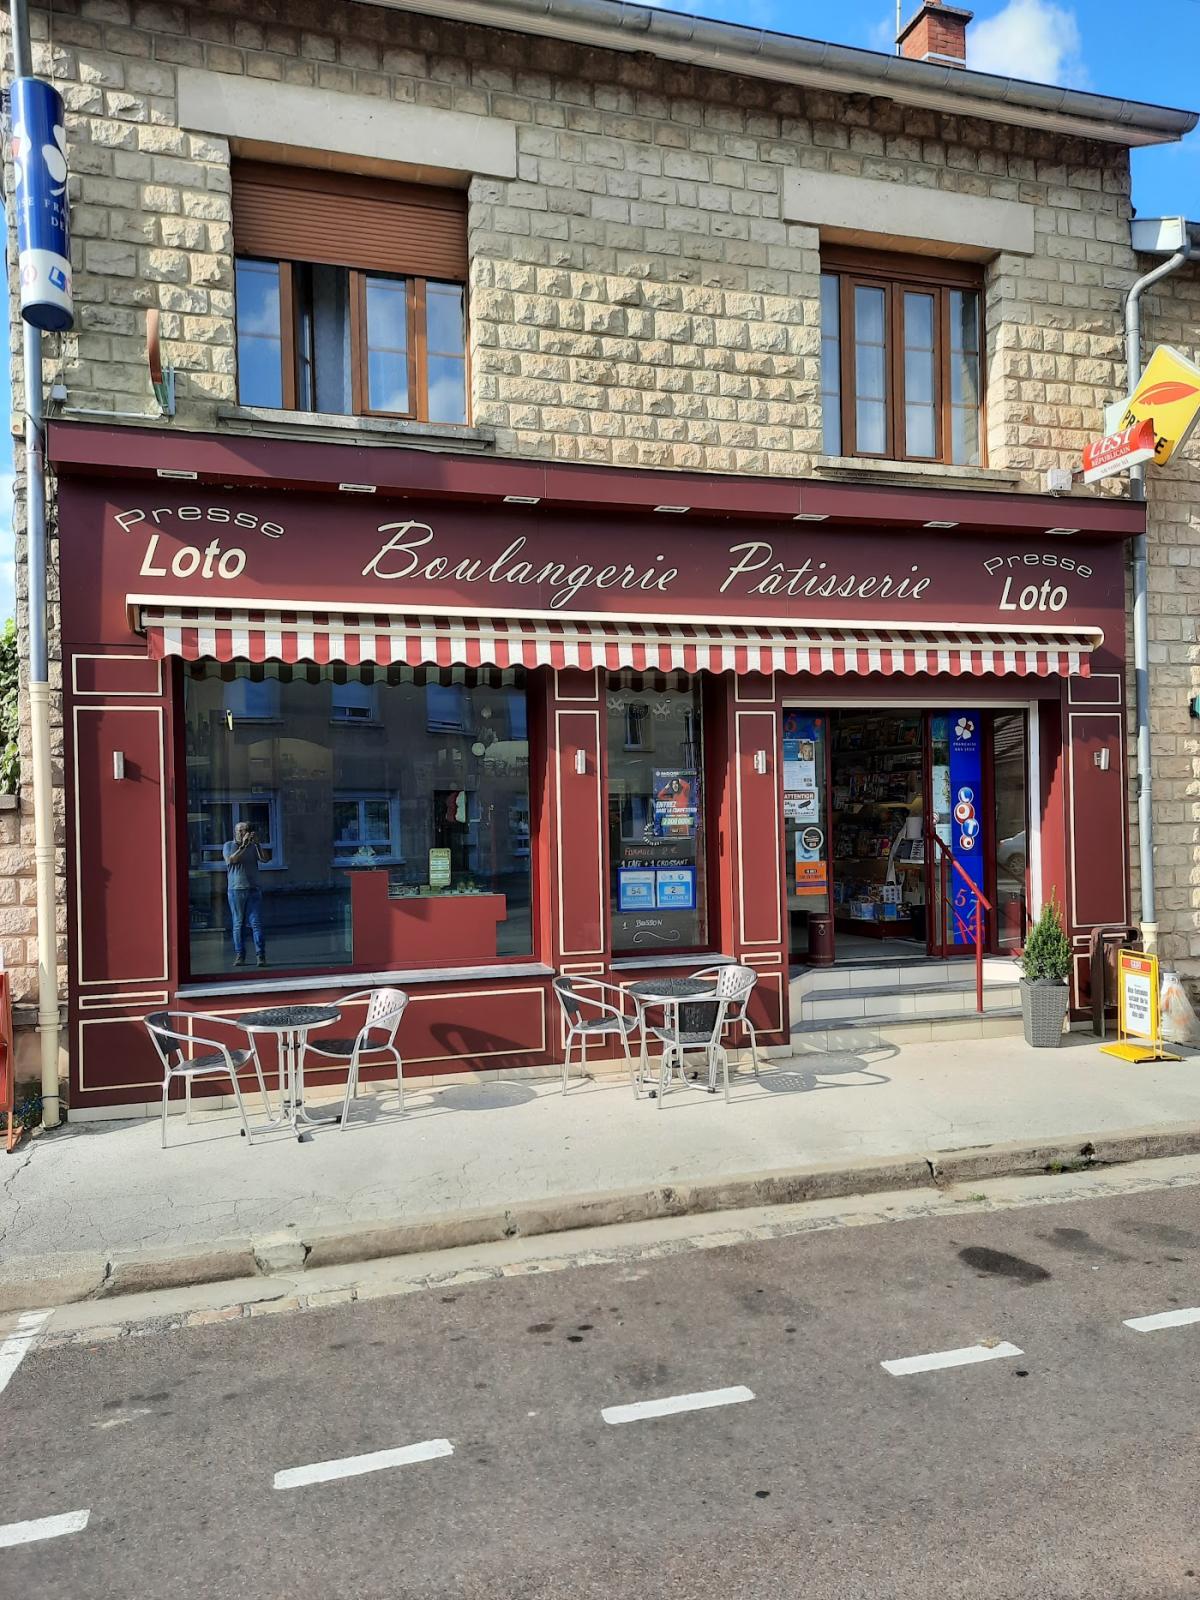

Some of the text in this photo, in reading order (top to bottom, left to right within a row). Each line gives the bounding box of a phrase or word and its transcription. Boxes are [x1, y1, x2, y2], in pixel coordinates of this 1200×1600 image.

[114, 506, 285, 539] Presse
[139, 534, 247, 580] Loto
[361, 519, 679, 609] Boulangerie
[719, 541, 932, 600] Pâtisserie
[983, 552, 1094, 580] Presse
[998, 577, 1069, 613] Loto
[954, 787, 979, 850] LOTO
